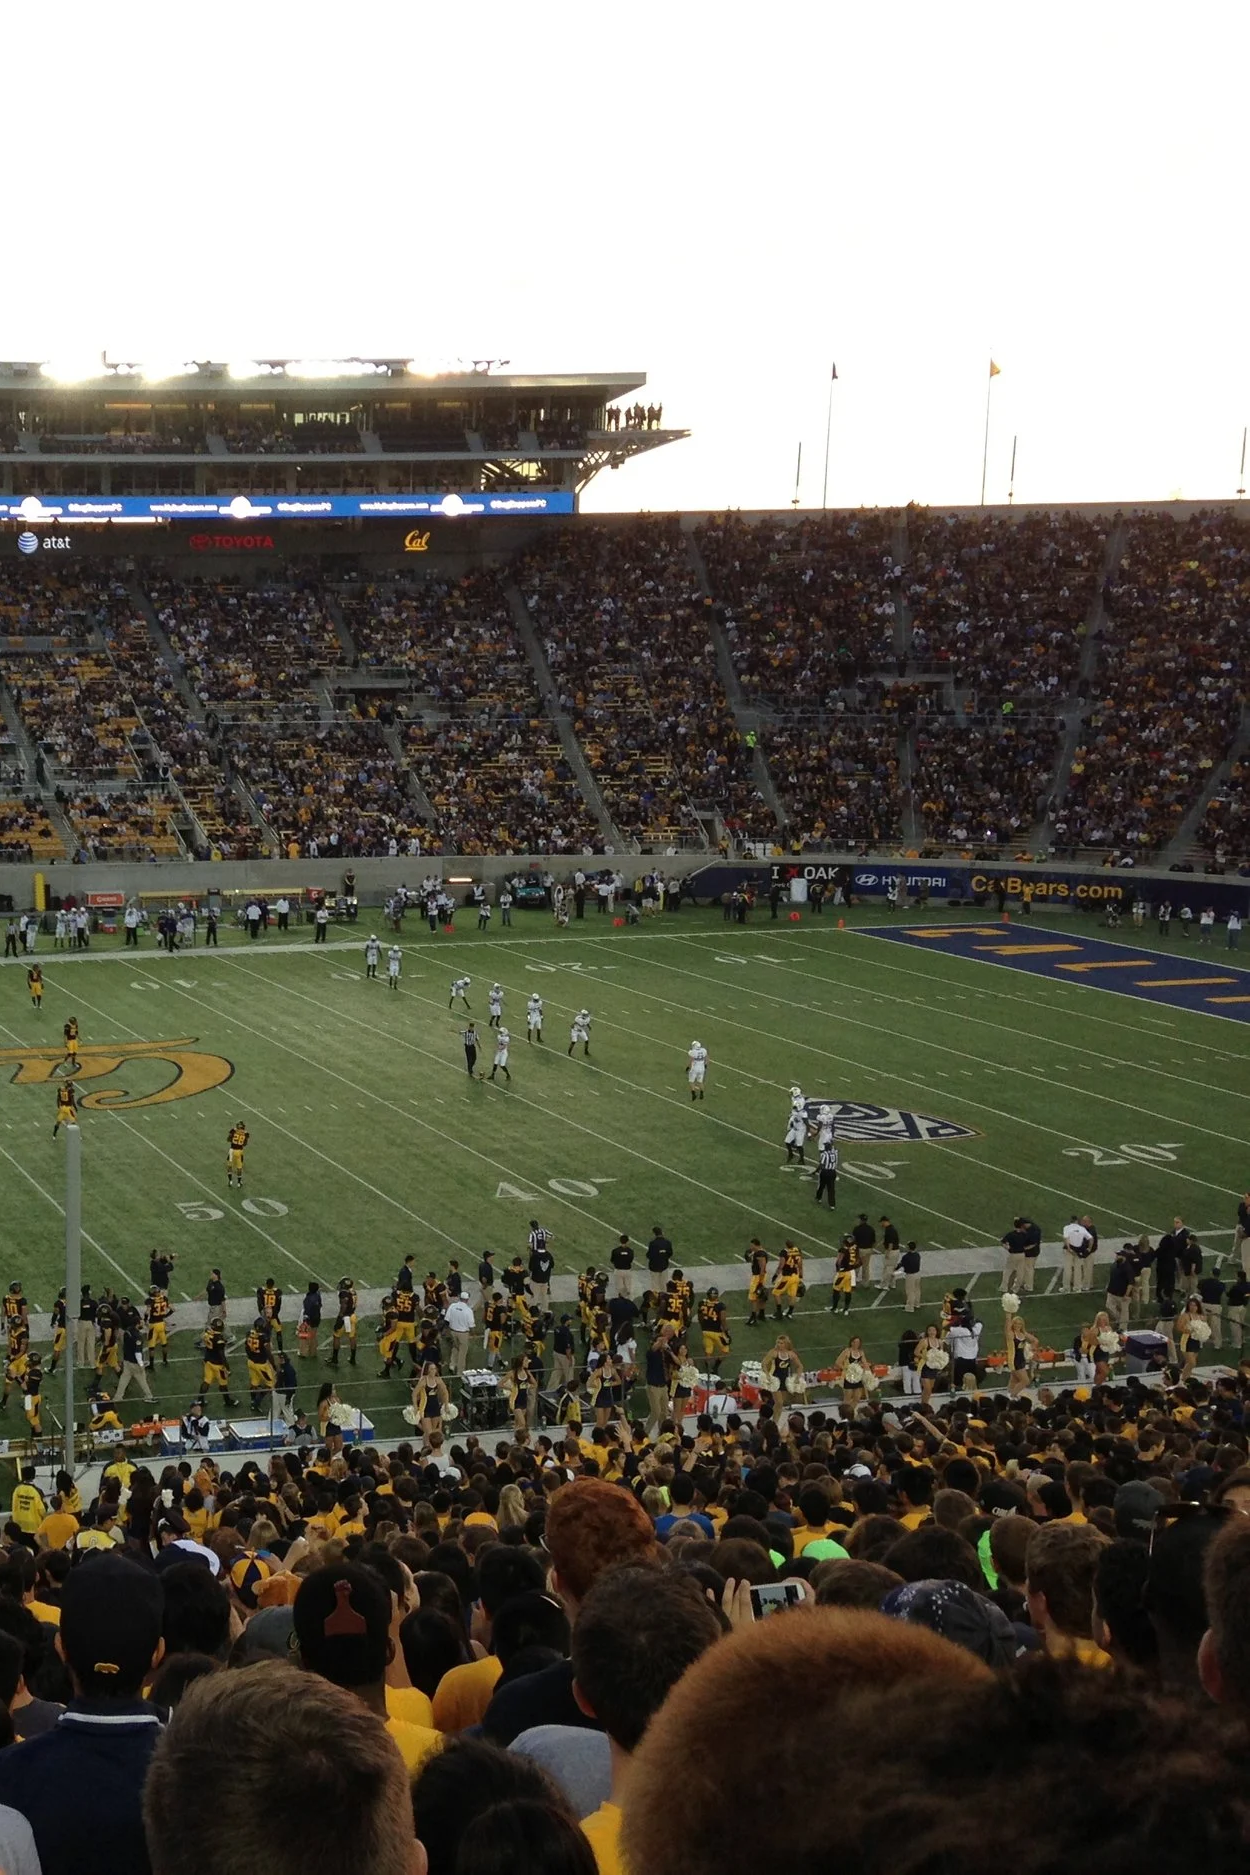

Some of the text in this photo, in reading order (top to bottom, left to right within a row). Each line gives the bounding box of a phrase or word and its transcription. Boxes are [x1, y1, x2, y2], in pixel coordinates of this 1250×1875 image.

[42, 536, 71, 550] at&t
[214, 536, 274, 548] TOYOTA
[405, 530, 430, 551] Cal
[803, 866, 839, 880] OAK
[231, 1133, 245, 1145] 28
[1062, 1142, 1177, 1167] 20
[495, 1178, 600, 1201] 40
[173, 1197, 289, 1222] 50
[263, 1295, 275, 1307] 18
[396, 1298, 412, 1312] 55
[153, 1303, 166, 1316] 33
